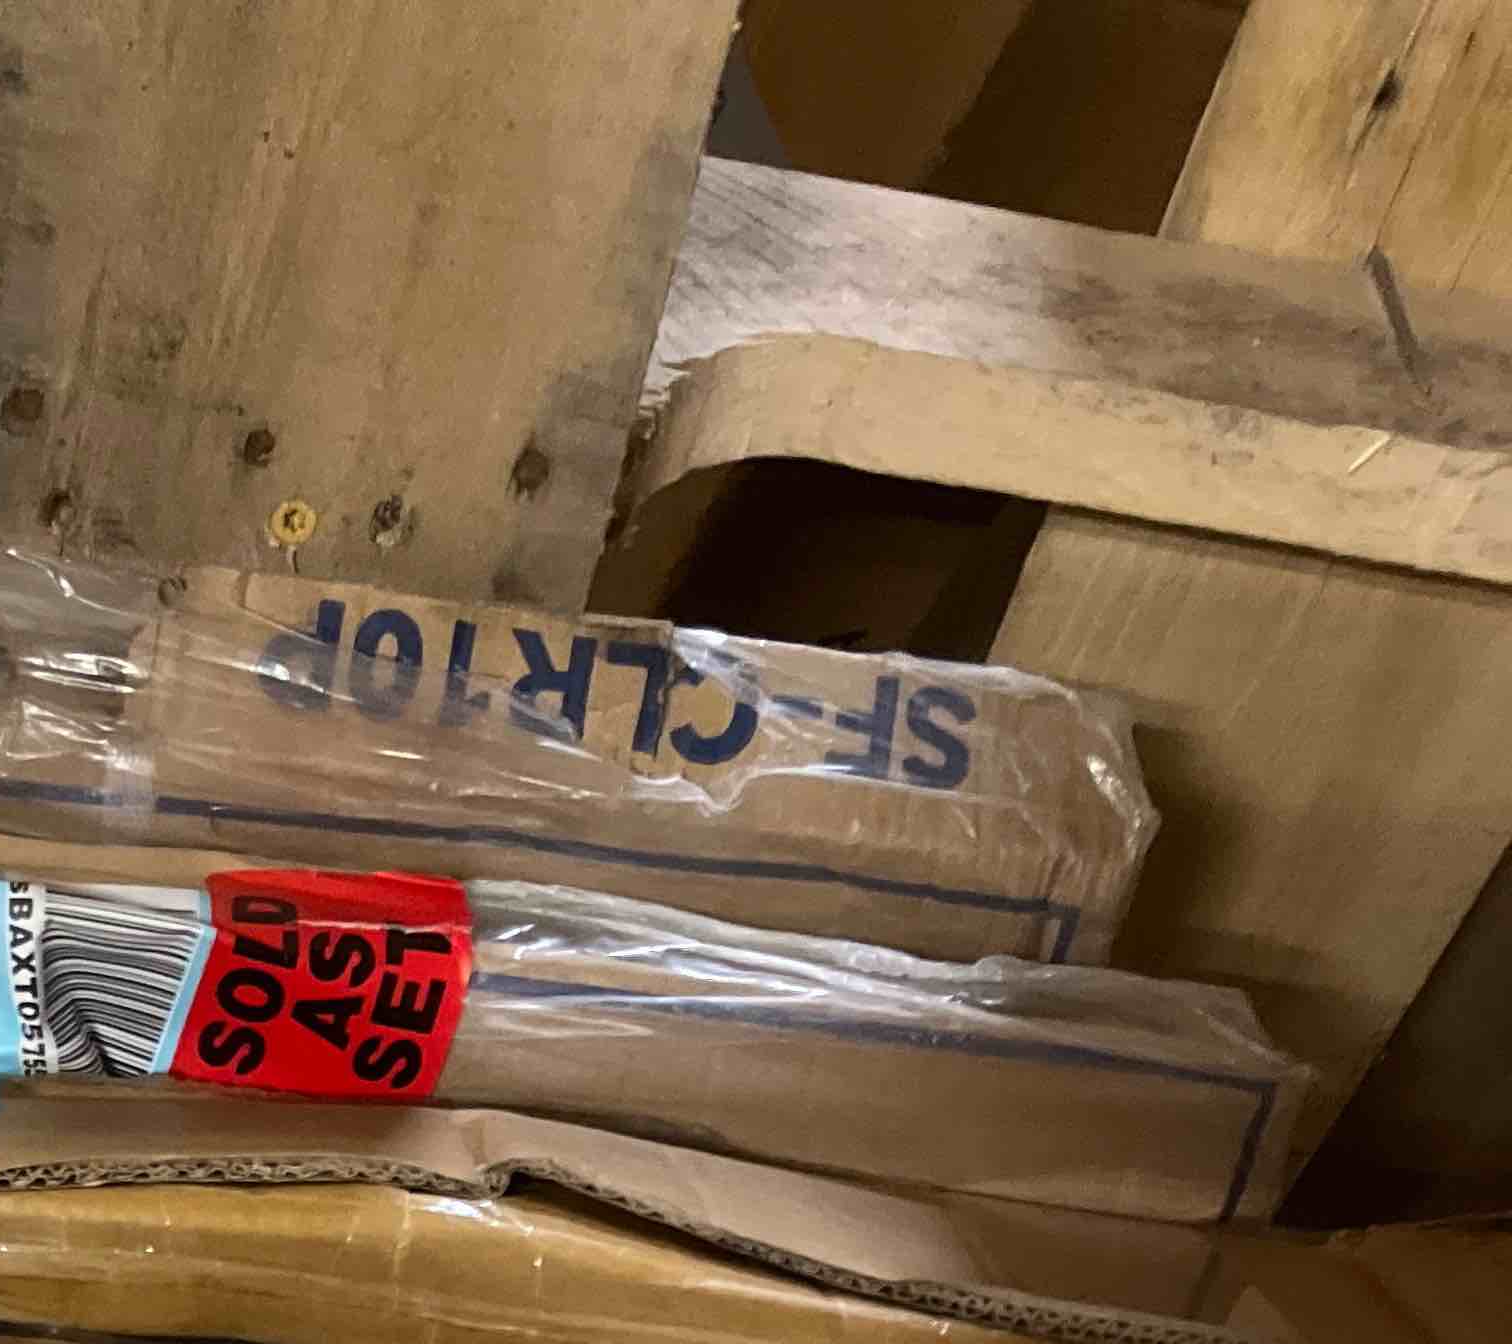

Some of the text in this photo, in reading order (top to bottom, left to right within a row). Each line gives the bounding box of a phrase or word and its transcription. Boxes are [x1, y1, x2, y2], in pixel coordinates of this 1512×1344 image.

[258, 599, 977, 790] SF-CLR10P
[198, 896, 299, 1075] SOLD
[291, 930, 376, 1051] AS
[352, 922, 452, 1088] SET
